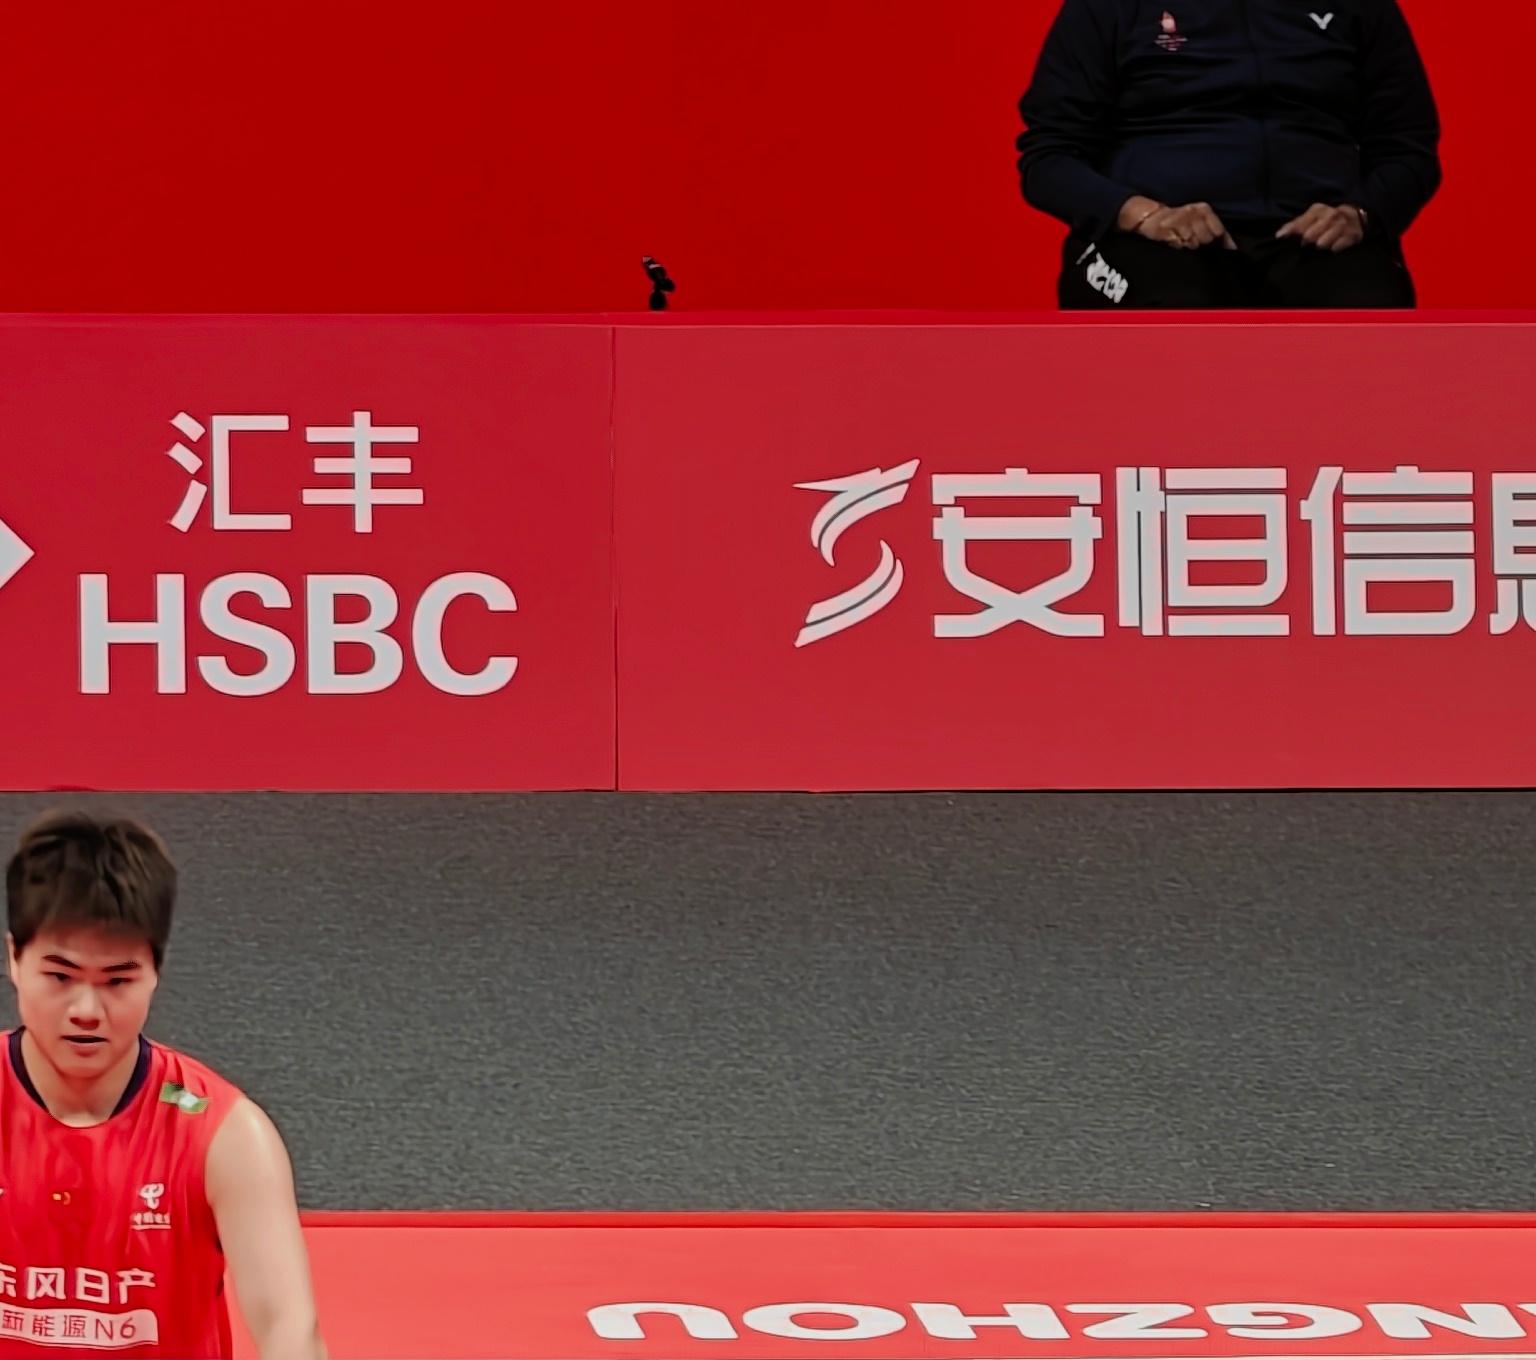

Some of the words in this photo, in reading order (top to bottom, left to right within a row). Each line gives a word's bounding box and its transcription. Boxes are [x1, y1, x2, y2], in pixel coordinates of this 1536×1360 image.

[168, 410, 424, 534] 汇丰
[931, 465, 1536, 638] 安恒信
[79, 571, 519, 697] HSBC
[585, 1301, 1536, 1341] NGZHOU
